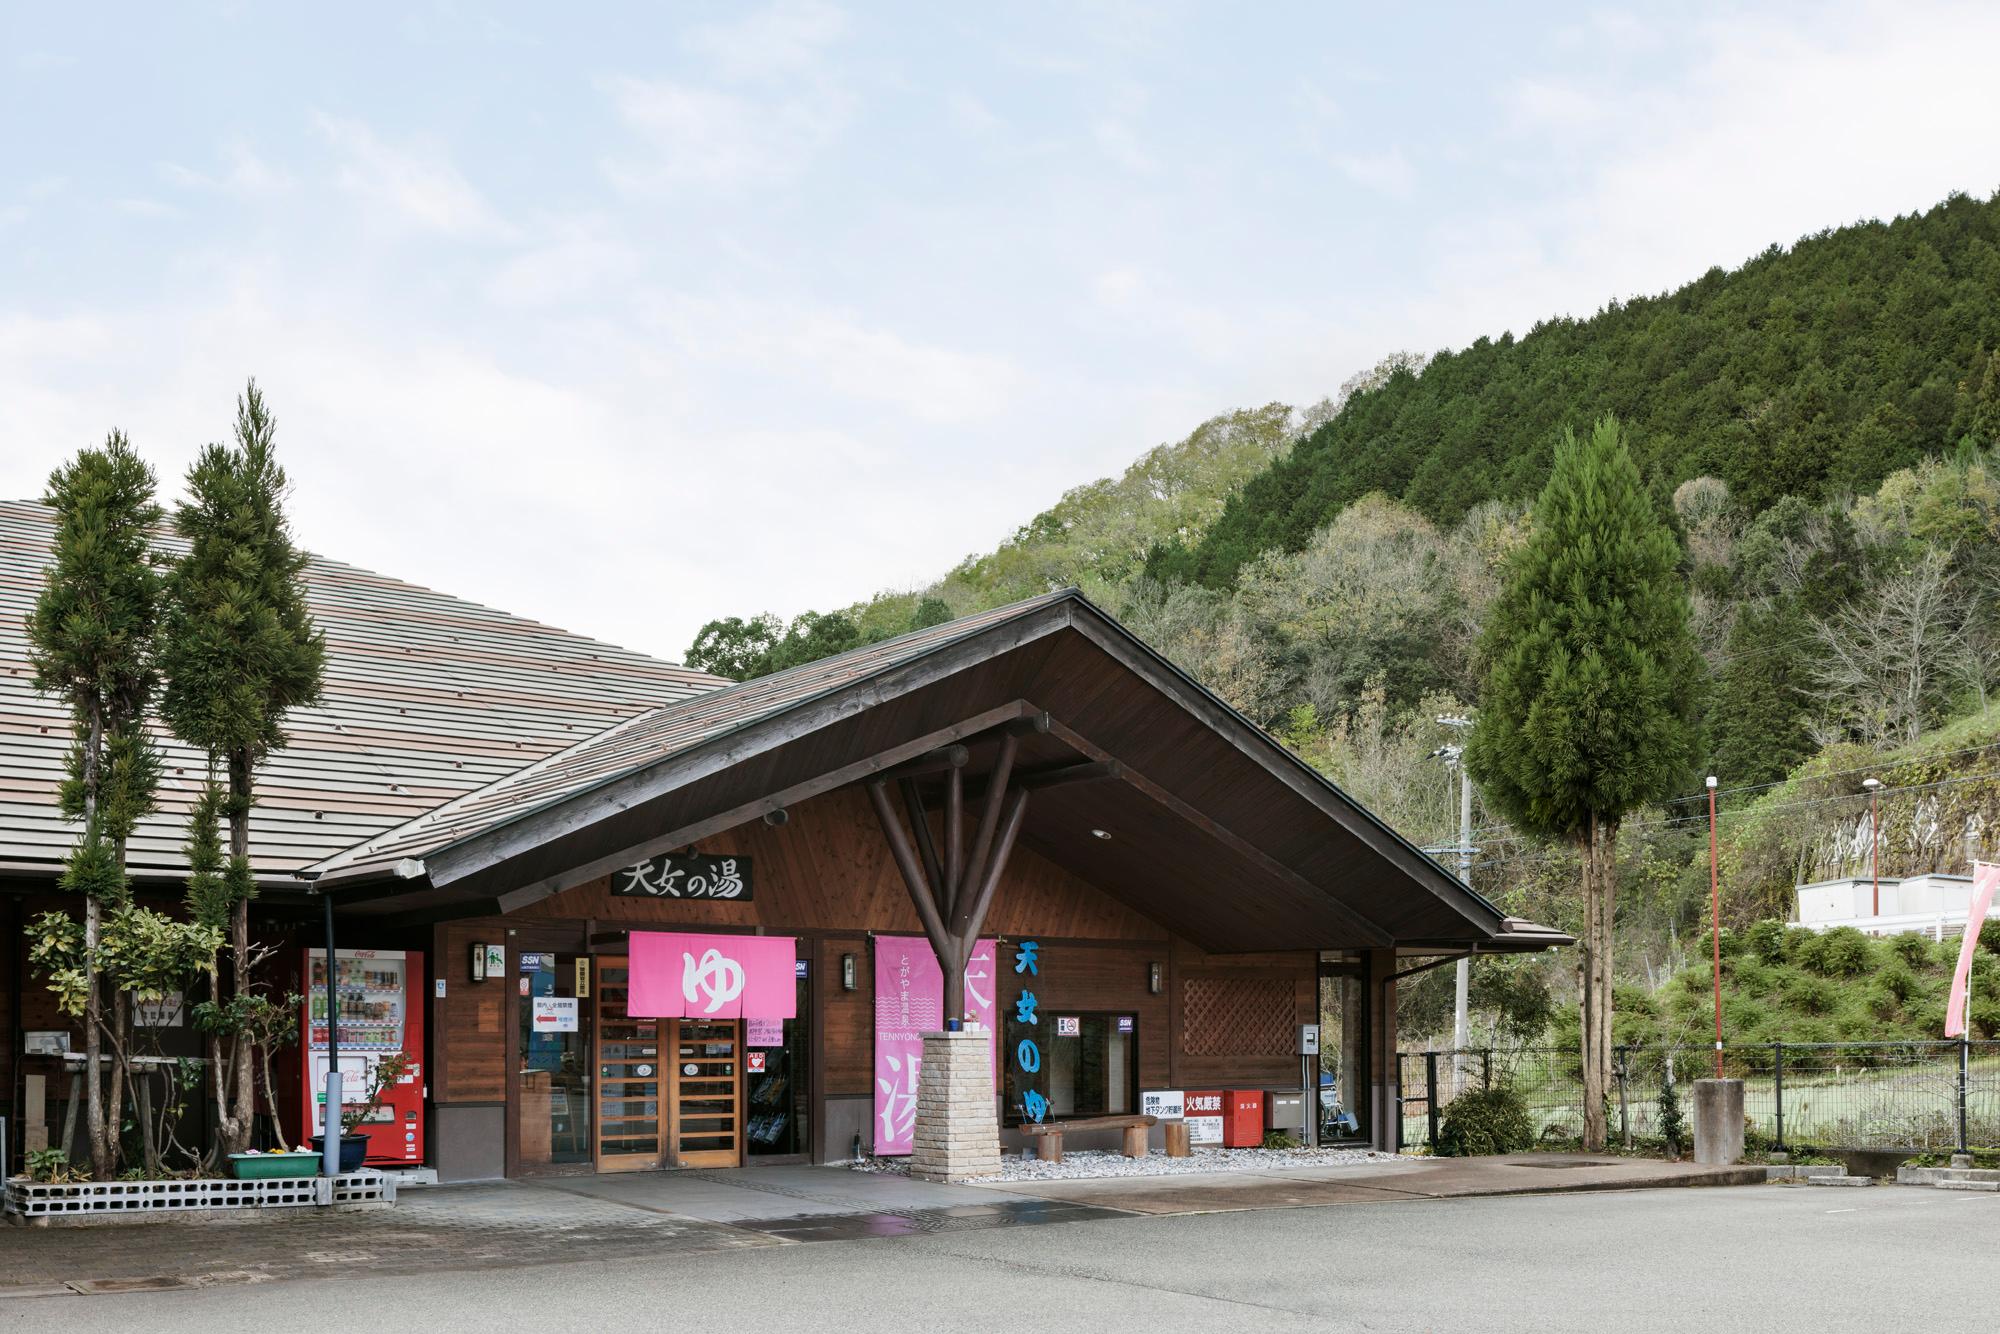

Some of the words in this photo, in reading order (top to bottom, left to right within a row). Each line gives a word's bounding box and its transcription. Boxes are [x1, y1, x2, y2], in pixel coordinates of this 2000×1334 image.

[622, 858, 744, 898] 天女の湯
[521, 955, 540, 965] SSN
[682, 948, 746, 1014] ゆ
[899, 954, 911, 1027] とがやま温泉
[1015, 941, 1047, 1123] 天女のゆ
[1186, 1096, 1221, 1111] 火気厳禁
